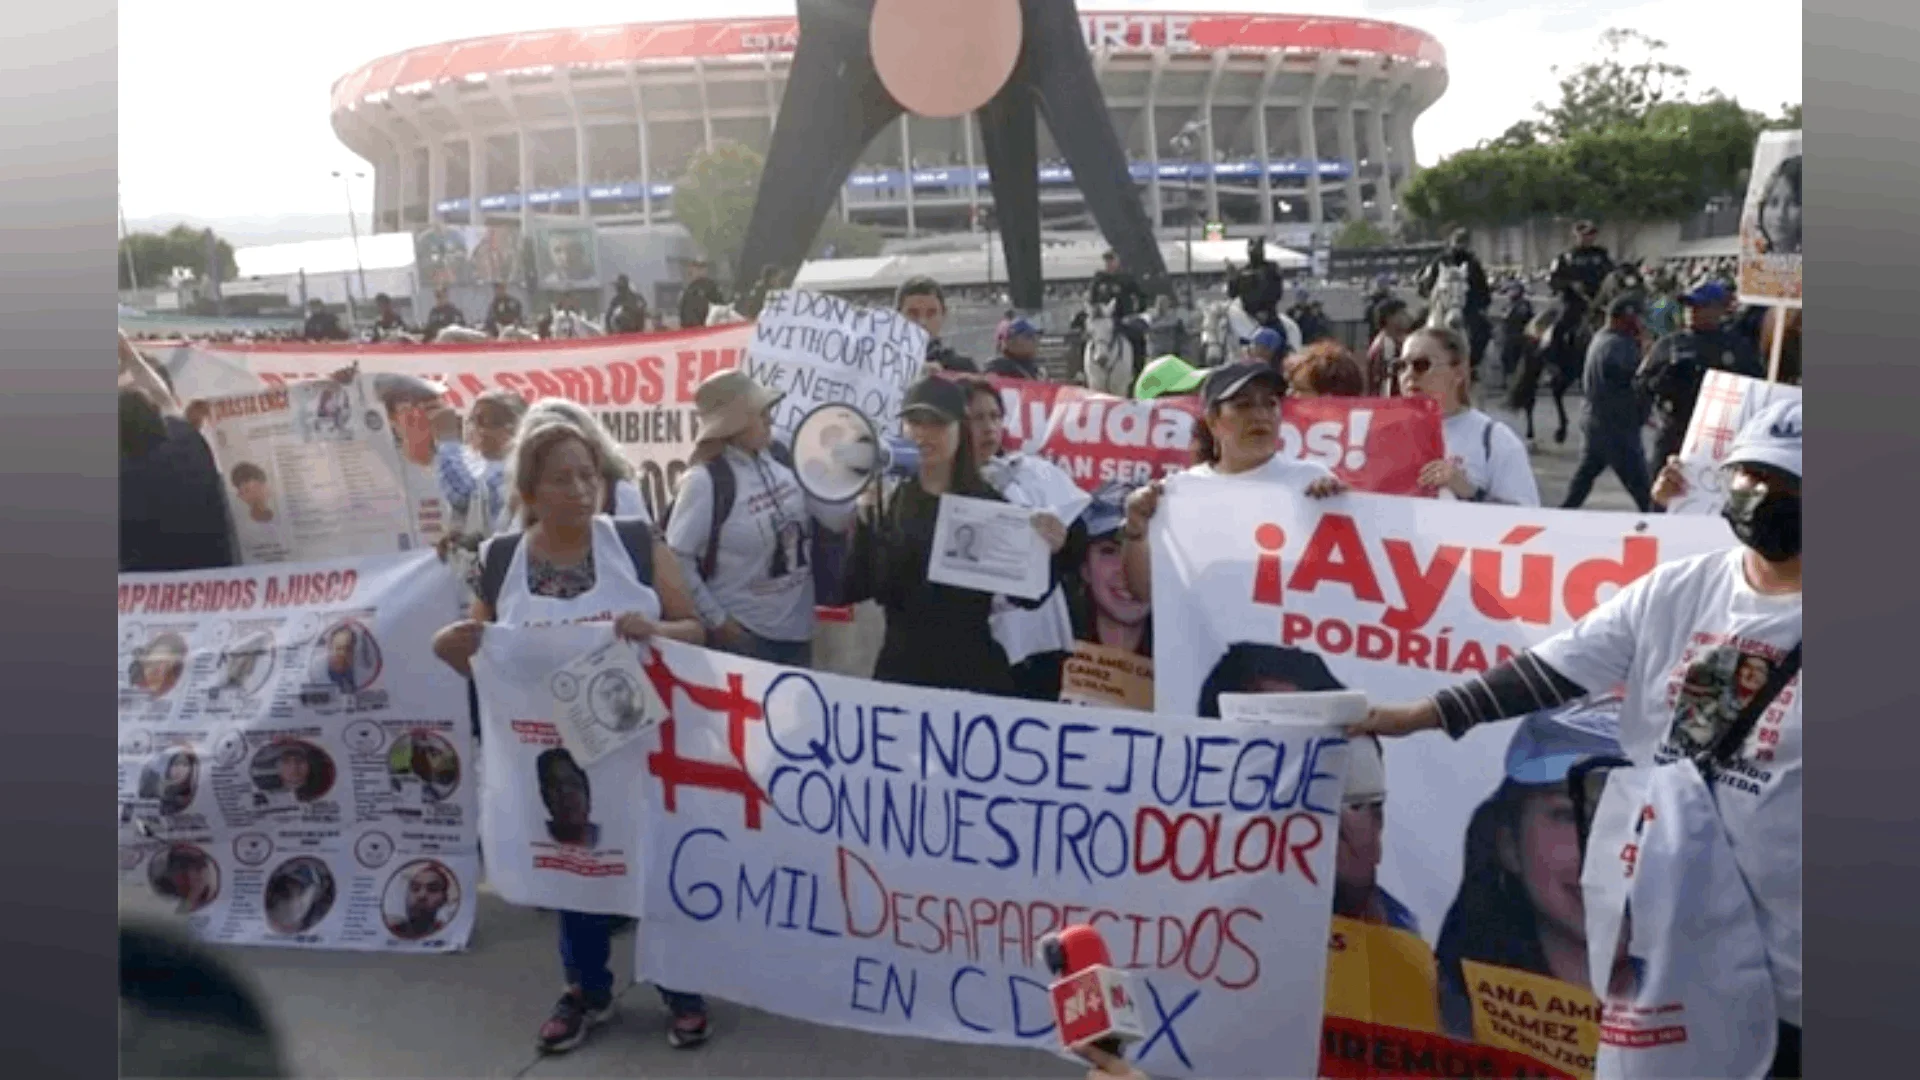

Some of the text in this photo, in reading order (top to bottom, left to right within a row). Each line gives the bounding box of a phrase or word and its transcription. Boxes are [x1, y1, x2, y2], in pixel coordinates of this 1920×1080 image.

[1079, 13, 1193, 52] RTE
[757, 322, 823, 354] WITH
[822, 328, 876, 374] OUR
[493, 356, 665, 405] CARLOS
[594, 404, 683, 444] MBIÉN
[119, 569, 358, 614] APARECIDOS AJUSCO
[762, 672, 905, 767] QUE
[919, 711, 1002, 783] NO
[1004, 716, 1098, 792] SE
[1103, 724, 1350, 815] JUEGUE
[767, 765, 1323, 885] CON NUESTRO DOLOR
[736, 861, 842, 937] MIL
[850, 956, 1201, 1069] EN CDX
[1477, 979, 1539, 1011] ANA
